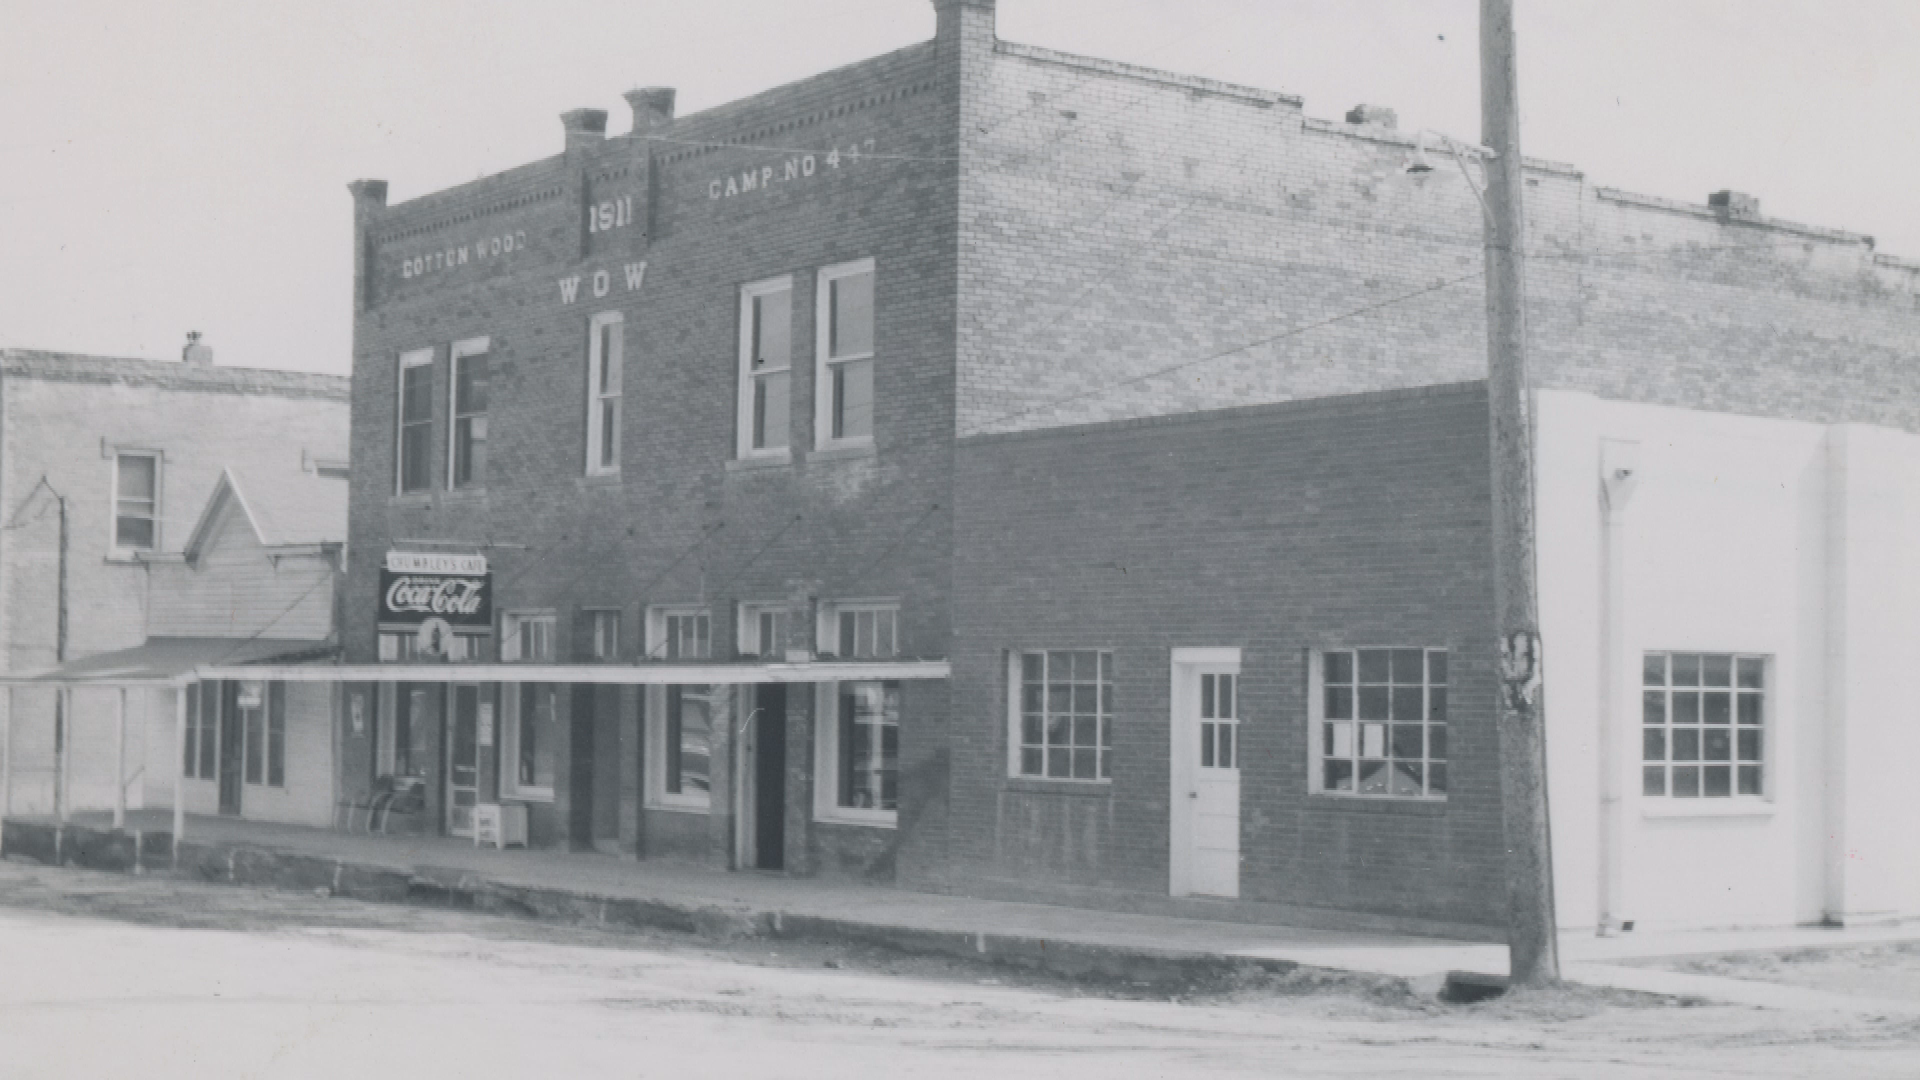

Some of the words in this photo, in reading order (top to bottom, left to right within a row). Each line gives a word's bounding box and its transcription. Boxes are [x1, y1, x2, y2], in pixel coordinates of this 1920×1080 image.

[708, 165, 772, 199] CAMP
[589, 195, 632, 233] 1911
[402, 244, 468, 279] COTTON
[476, 229, 527, 259] WOOD
[461, 560, 484, 573] CAFE
[386, 576, 484, 613] Coca-Cola
